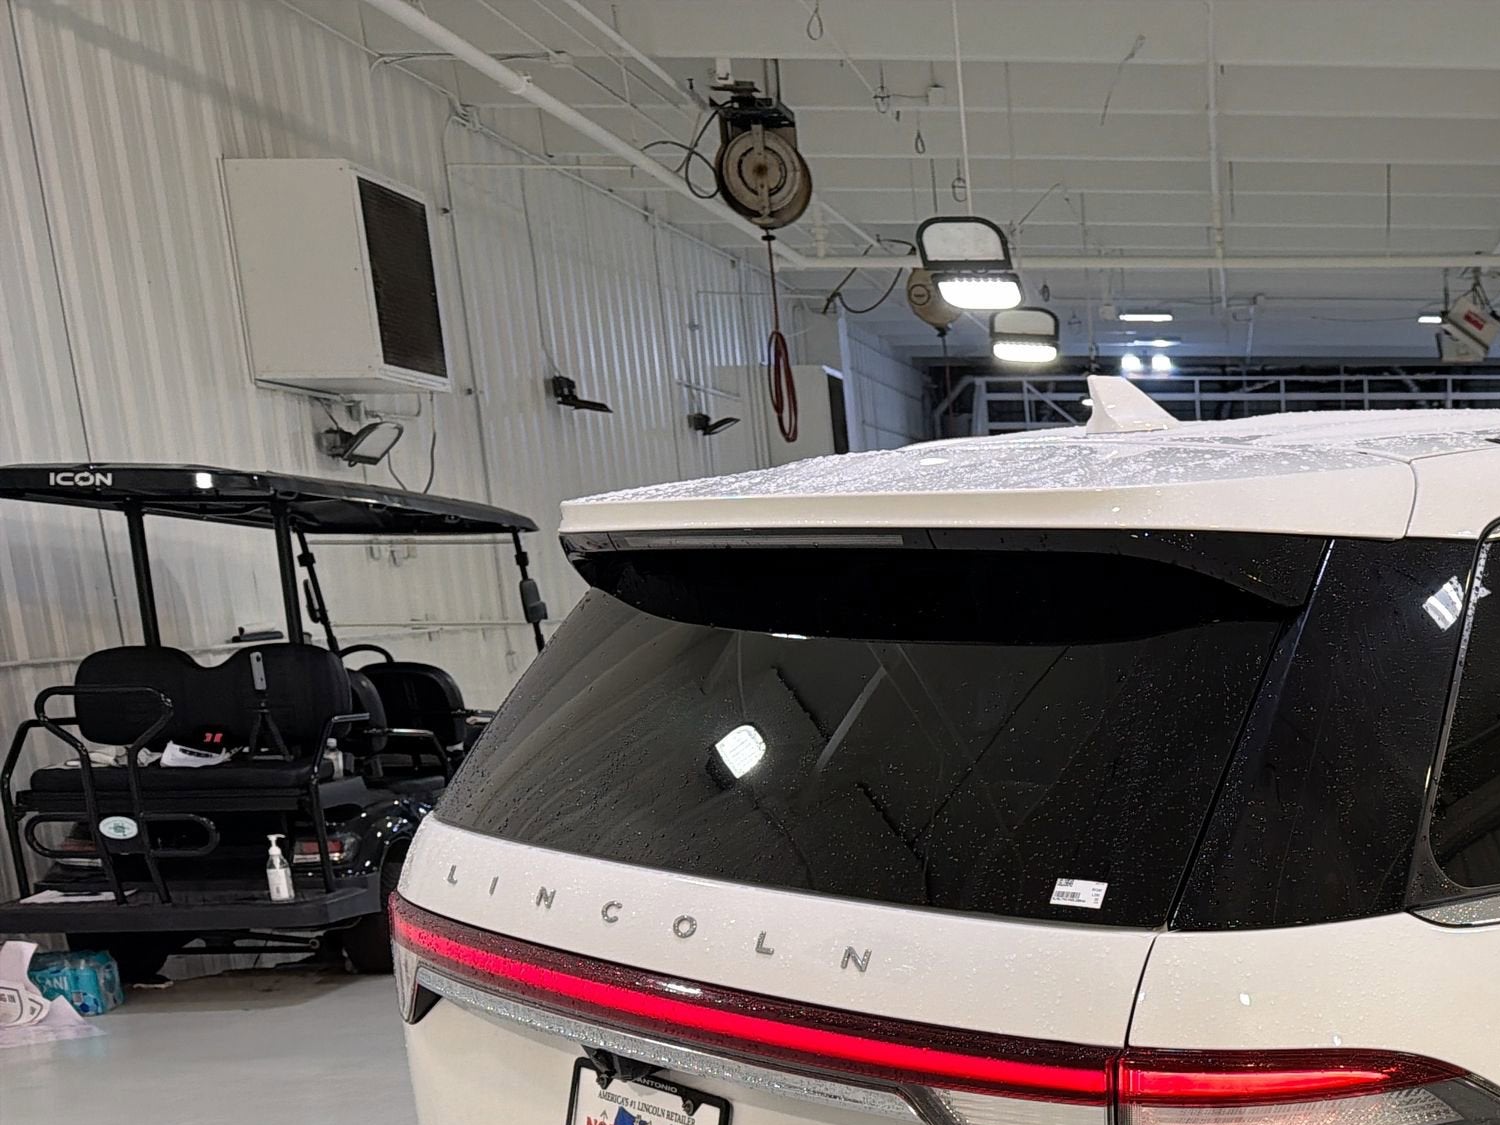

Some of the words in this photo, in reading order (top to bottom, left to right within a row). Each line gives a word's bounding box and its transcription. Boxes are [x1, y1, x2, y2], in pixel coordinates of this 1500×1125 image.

[49, 471, 113, 487] ICON
[446, 864, 872, 973] LINCOLN
[637, 1102, 666, 1119] LINCOLN
